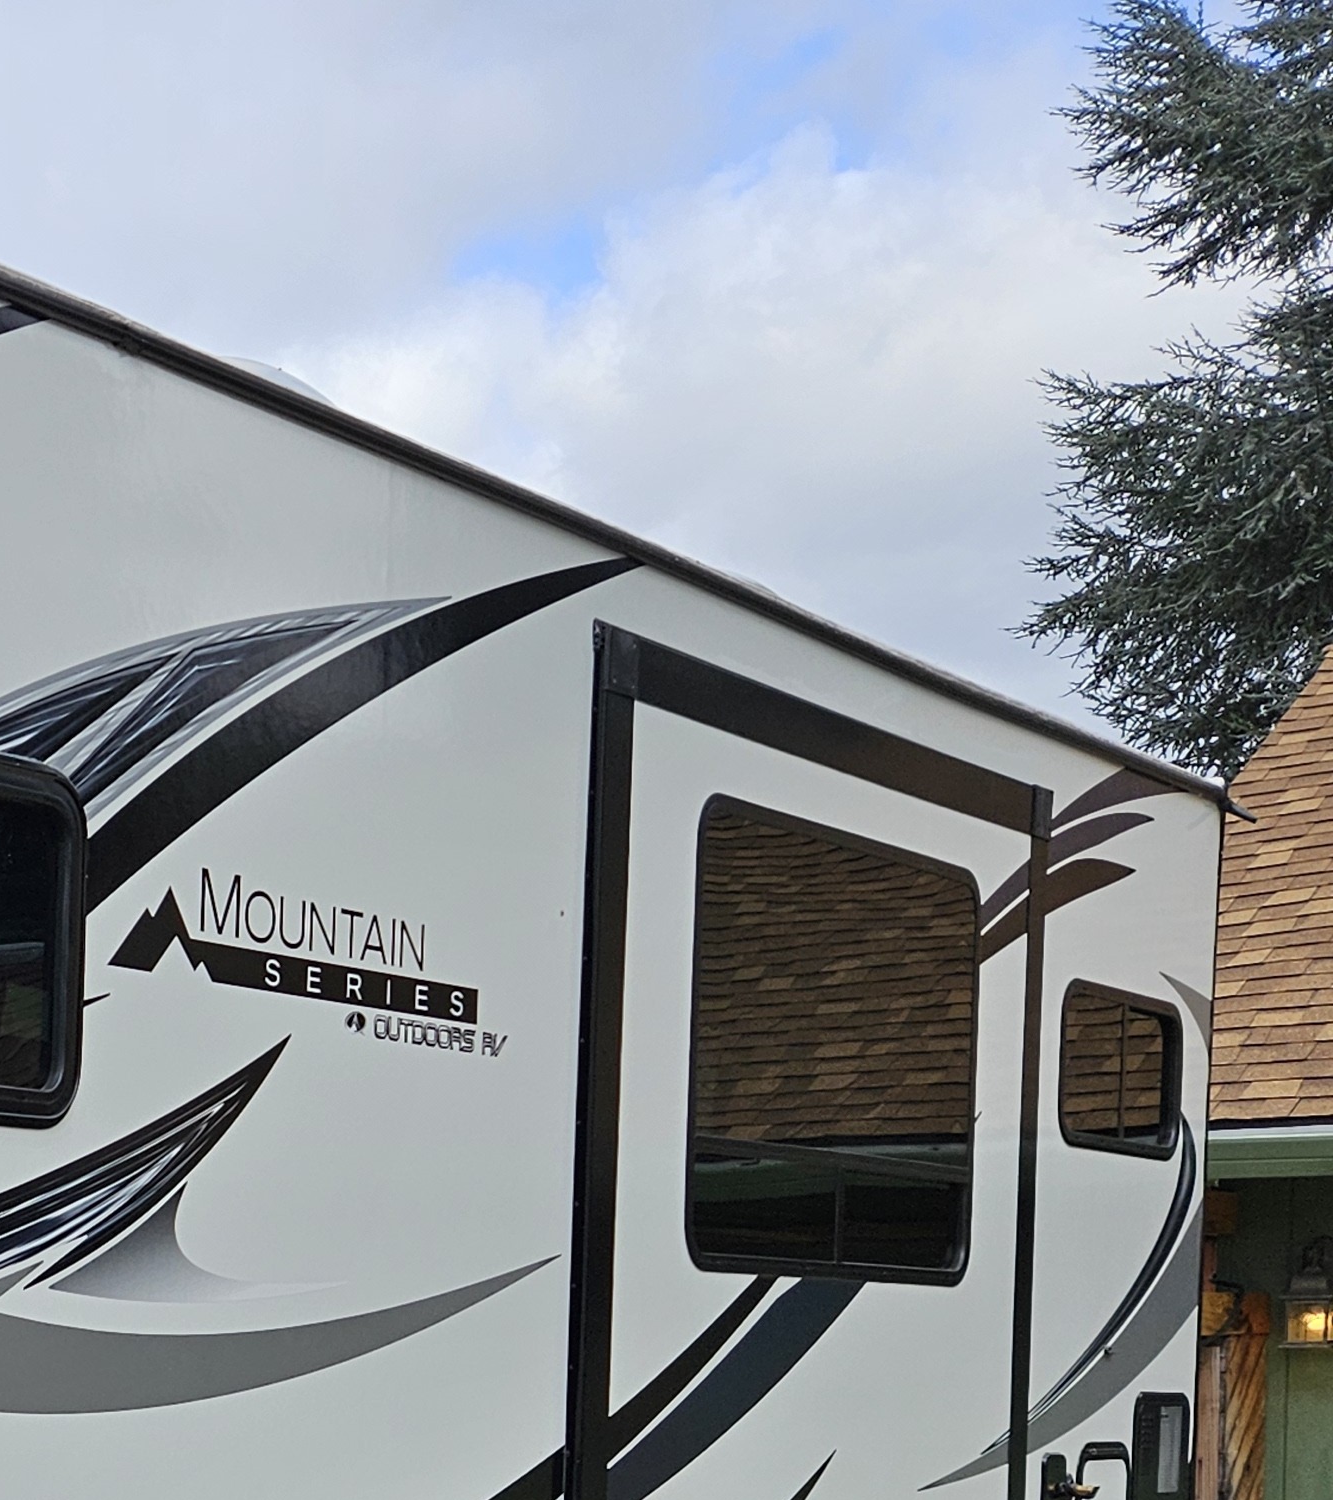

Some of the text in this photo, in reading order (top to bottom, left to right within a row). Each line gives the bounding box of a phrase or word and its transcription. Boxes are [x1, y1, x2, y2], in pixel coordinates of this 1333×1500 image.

[199, 867, 426, 972] MOUNTAIN
[263, 958, 465, 1017] SERIES
[374, 1014, 508, 1058] OUTDOORS RV
